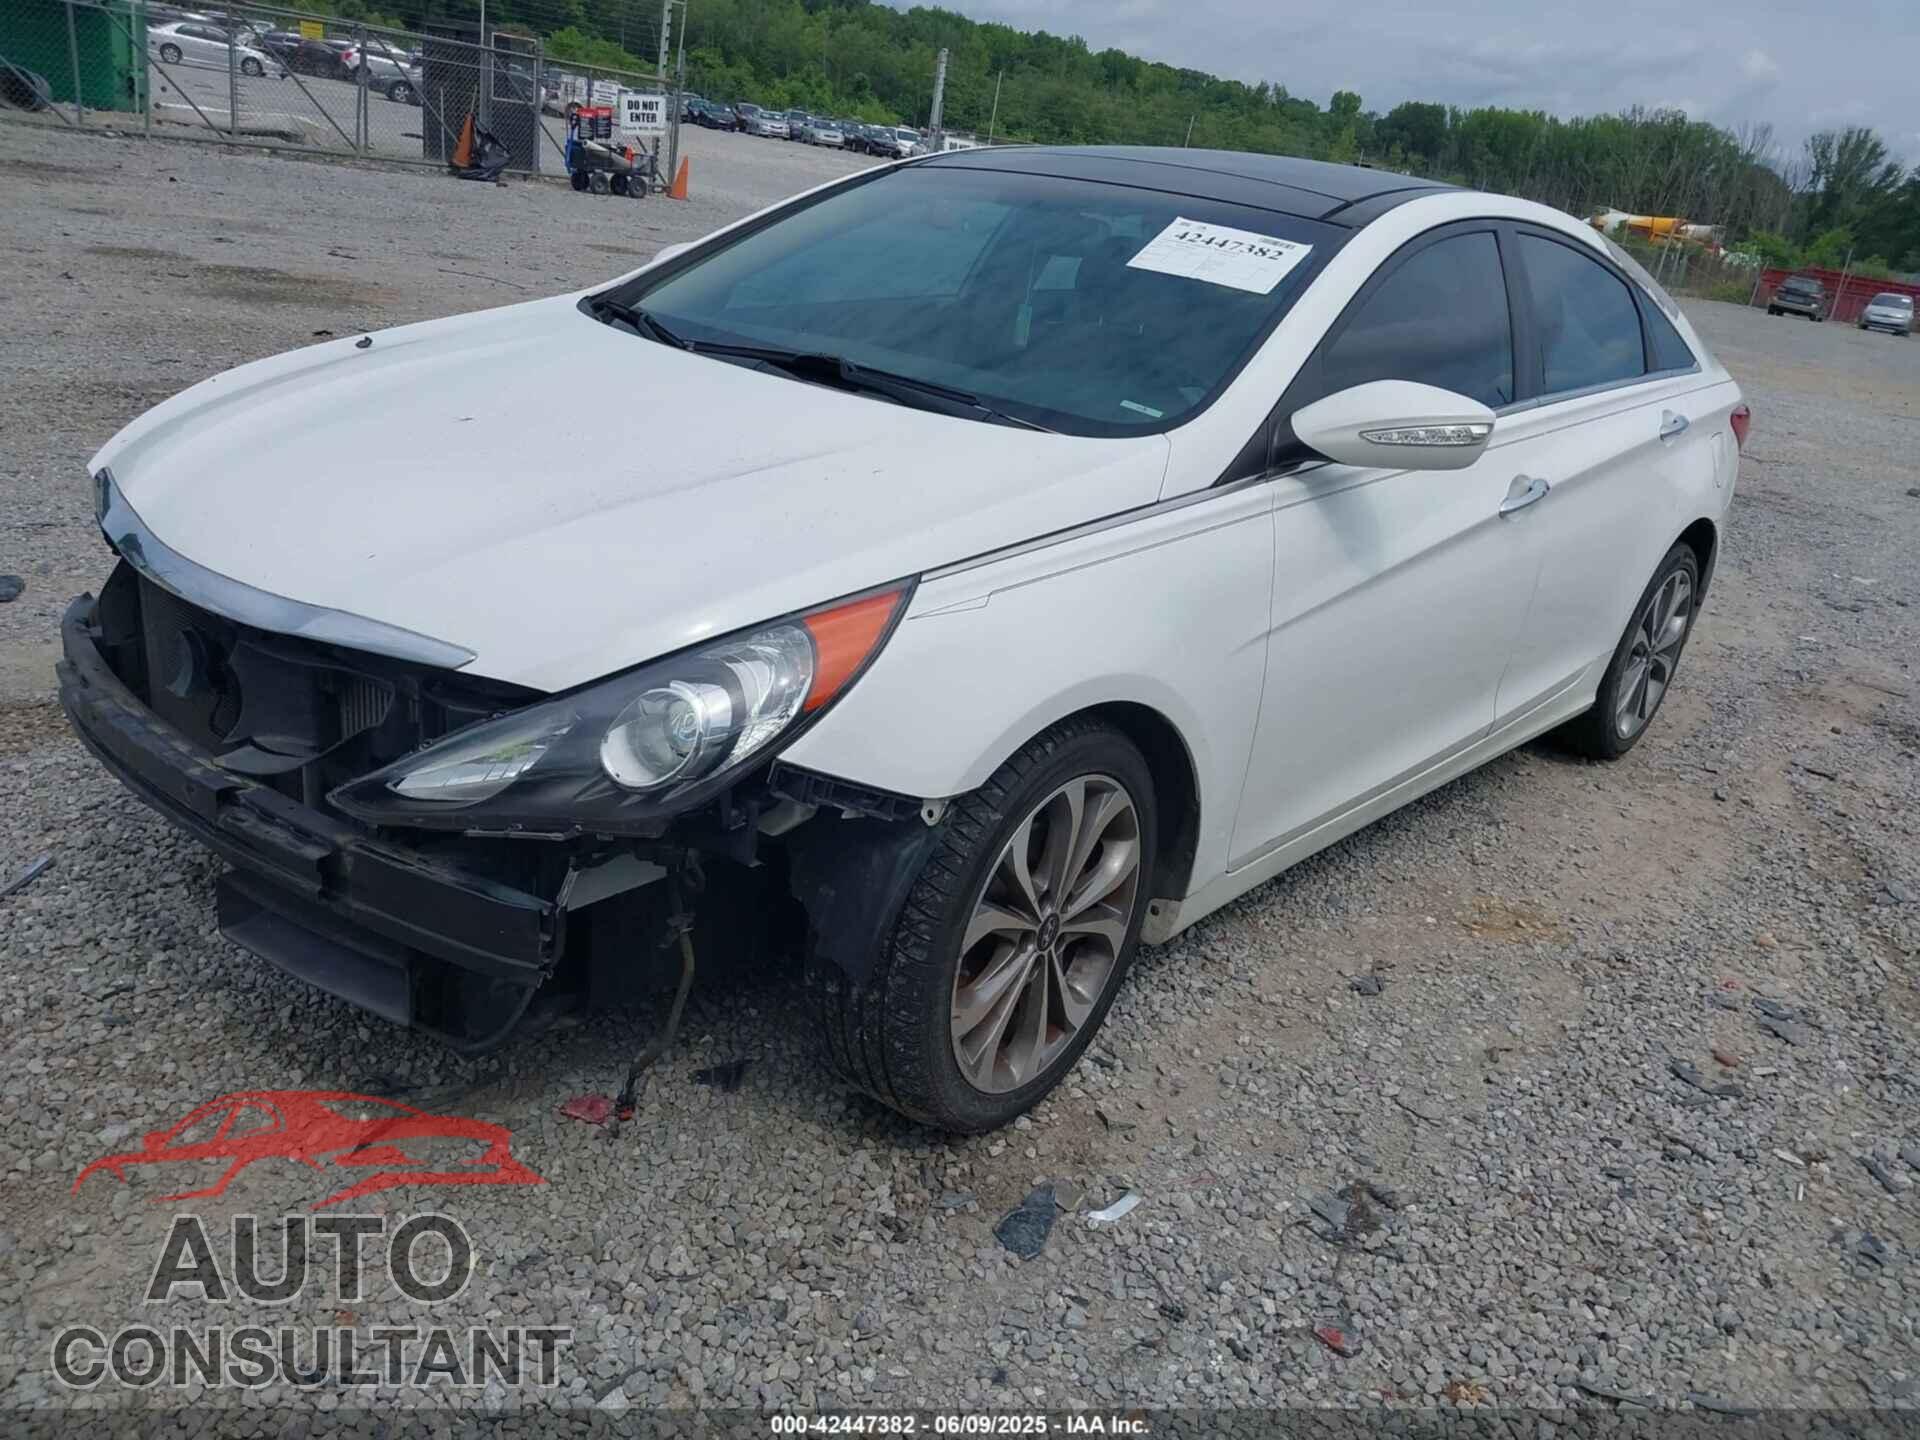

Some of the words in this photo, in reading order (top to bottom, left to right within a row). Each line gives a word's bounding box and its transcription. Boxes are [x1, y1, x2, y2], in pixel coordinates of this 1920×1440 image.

[627, 100, 640, 110] DO
[642, 101, 659, 111] NOT
[630, 112, 657, 123] ENTER
[1174, 231, 1283, 260] 42447382
